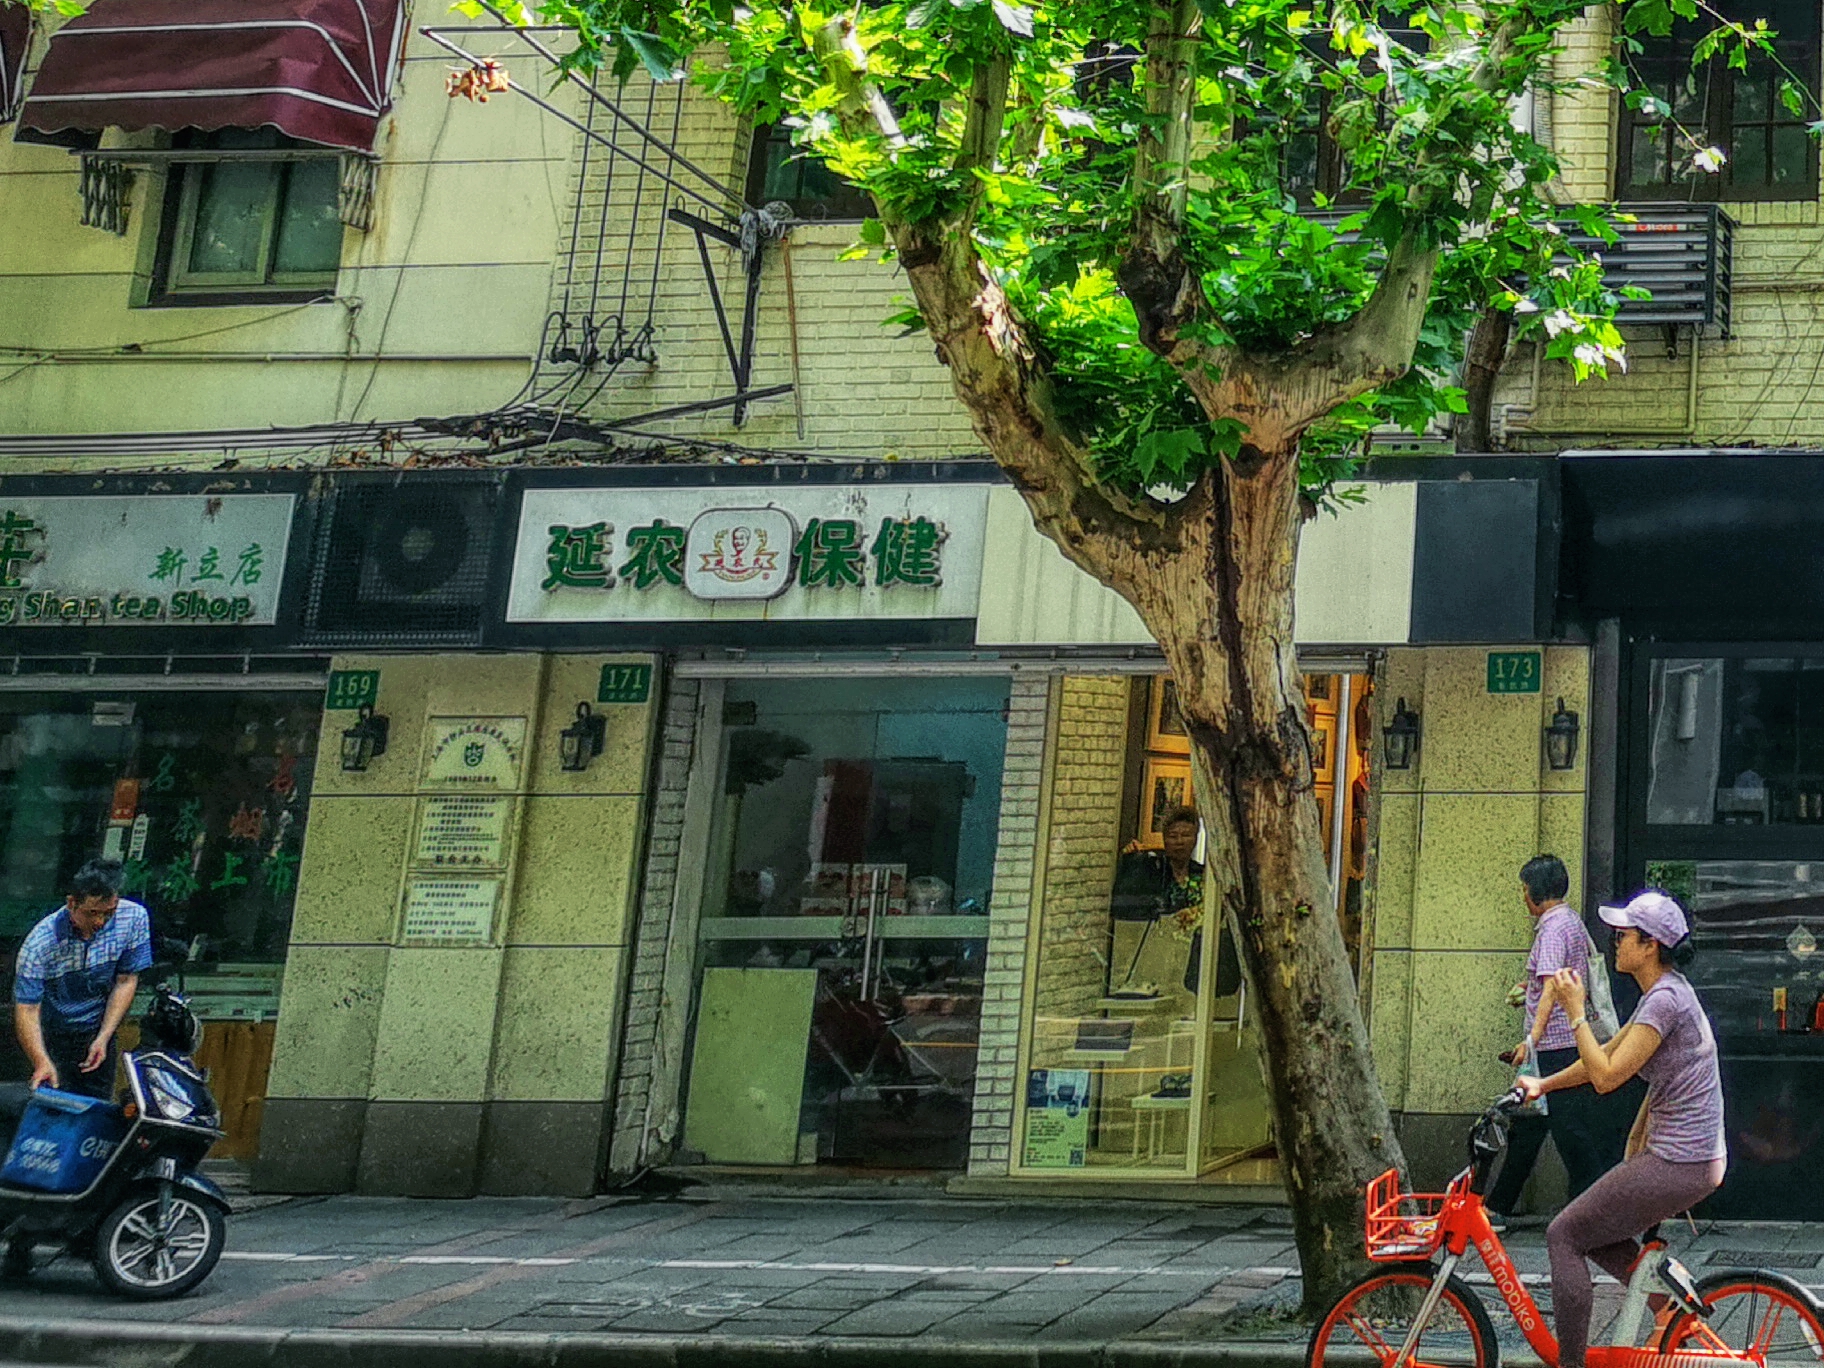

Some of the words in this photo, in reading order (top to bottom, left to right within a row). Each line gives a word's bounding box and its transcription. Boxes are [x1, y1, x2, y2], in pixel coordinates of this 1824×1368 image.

[149, 542, 264, 587] 新立店
[542, 519, 684, 590] 延农
[795, 516, 940, 588] 保健
[23, 590, 102, 620] Shan
[110, 592, 162, 619] tea
[169, 589, 251, 622] Shop
[606, 667, 642, 690] 171
[1495, 658, 1533, 679] 173
[335, 676, 371, 696] 169
[1494, 1266, 1535, 1331] mobike
